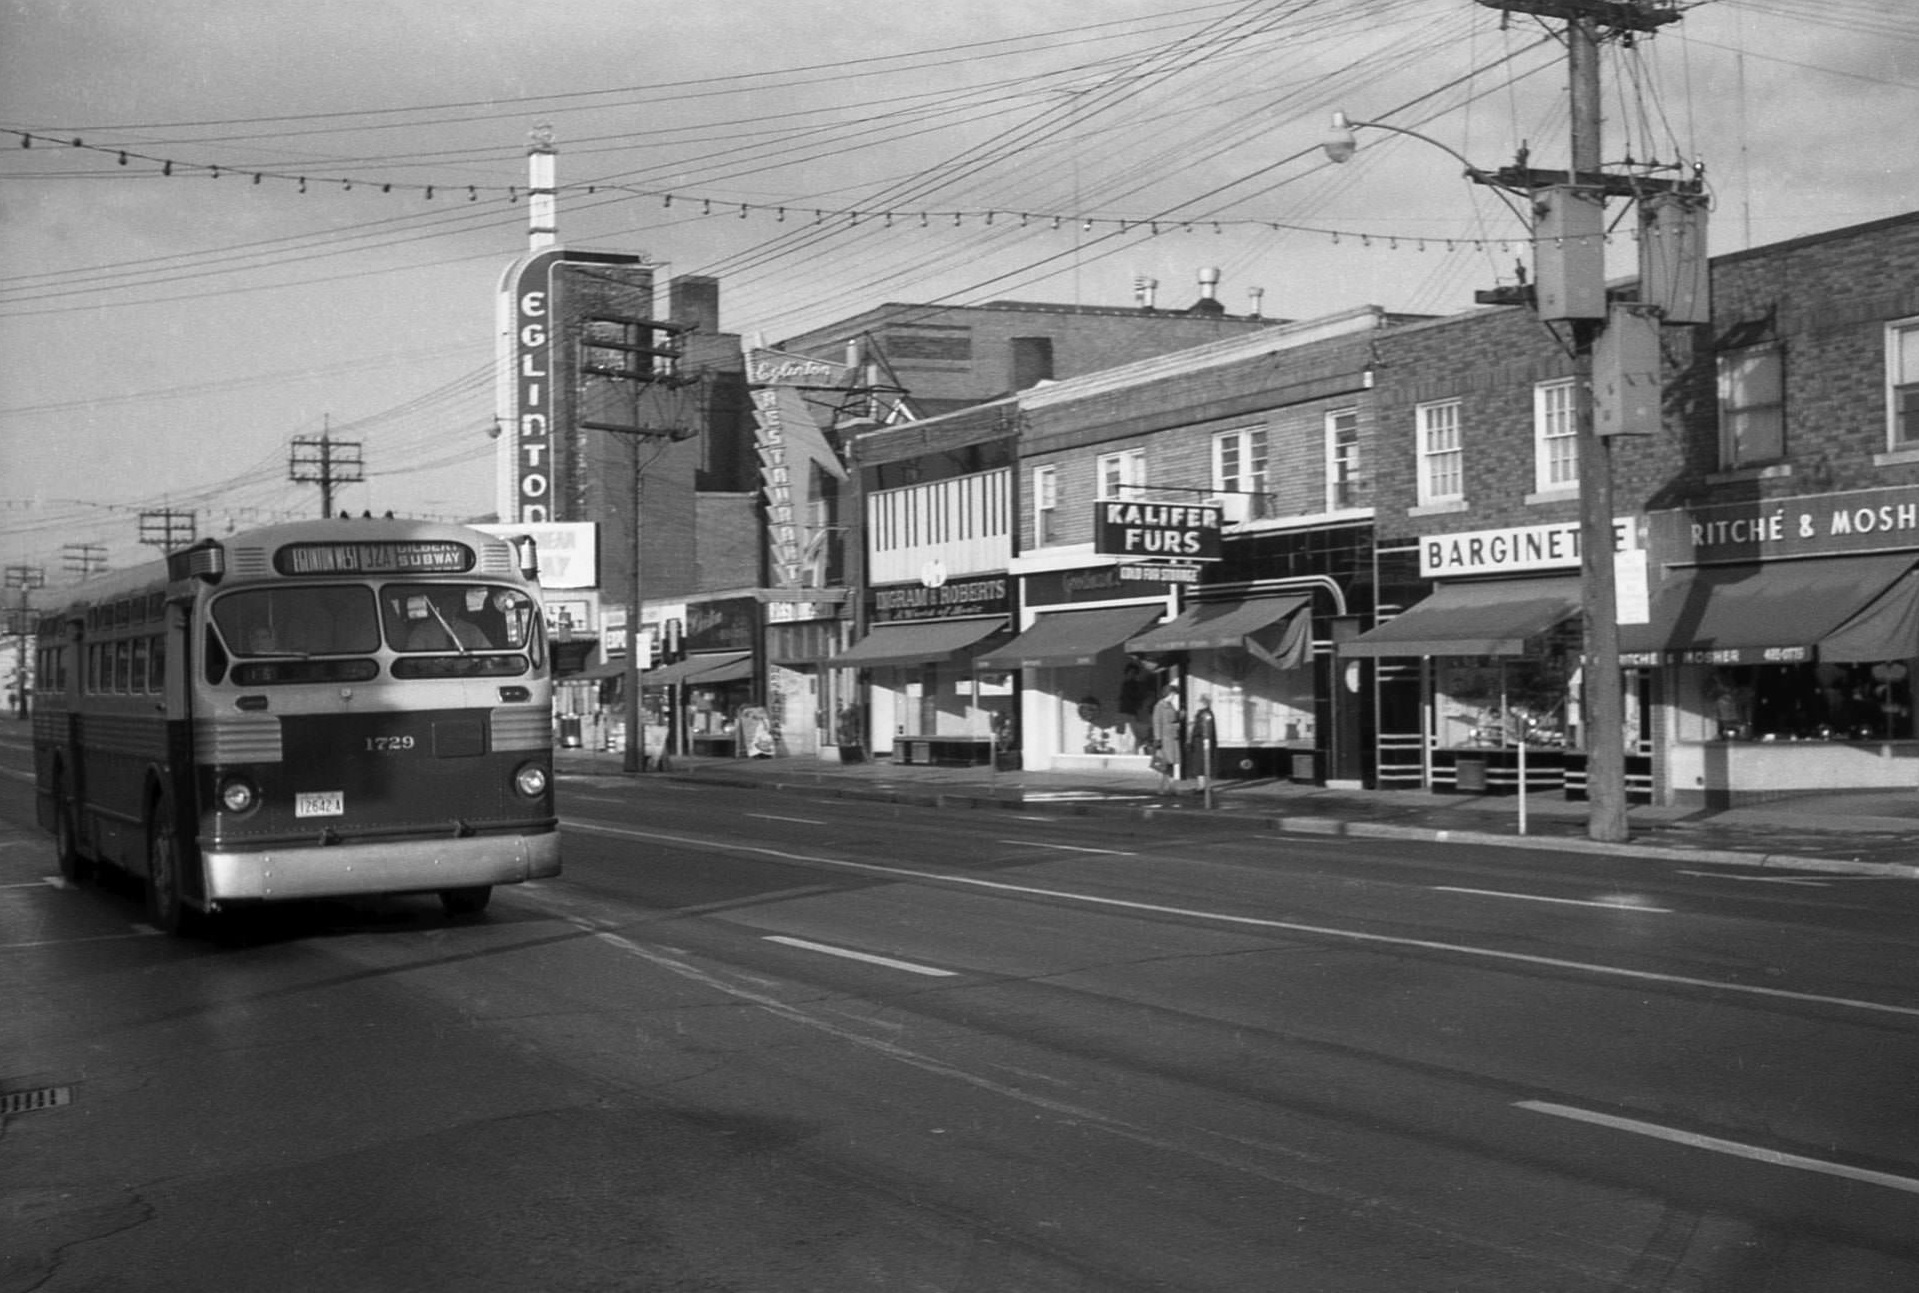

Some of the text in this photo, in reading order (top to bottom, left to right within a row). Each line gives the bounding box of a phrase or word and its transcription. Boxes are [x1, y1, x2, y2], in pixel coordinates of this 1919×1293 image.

[1107, 504, 1217, 528] KALIFER
[1691, 509, 1784, 546] RITCHÉ
[1799, 514, 1814, 538] &
[1125, 529, 1201, 553] FURS
[1428, 525, 1626, 568] BARGINETE
[398, 553, 460, 567] SUBWAY
[940, 580, 1006, 605] ROBERTS
[1683, 650, 1739, 664] MOSHER
[366, 736, 415, 751] 1729
